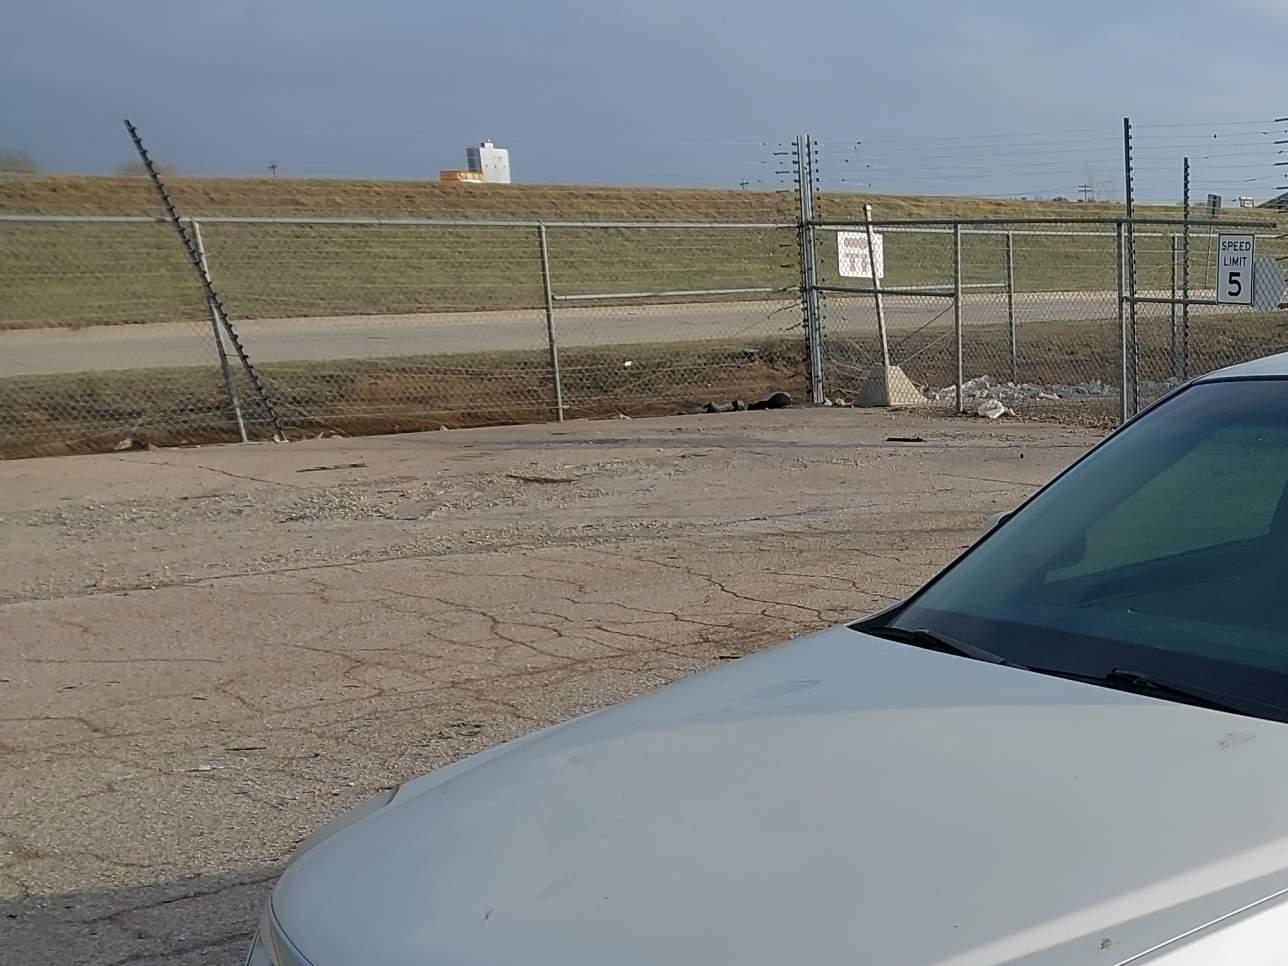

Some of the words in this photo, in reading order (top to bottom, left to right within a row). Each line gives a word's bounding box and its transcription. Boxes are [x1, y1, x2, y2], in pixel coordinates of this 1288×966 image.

[1221, 241, 1251, 251] SPEED
[1223, 256, 1248, 267] LIMIT
[1228, 272, 1241, 296] 5
